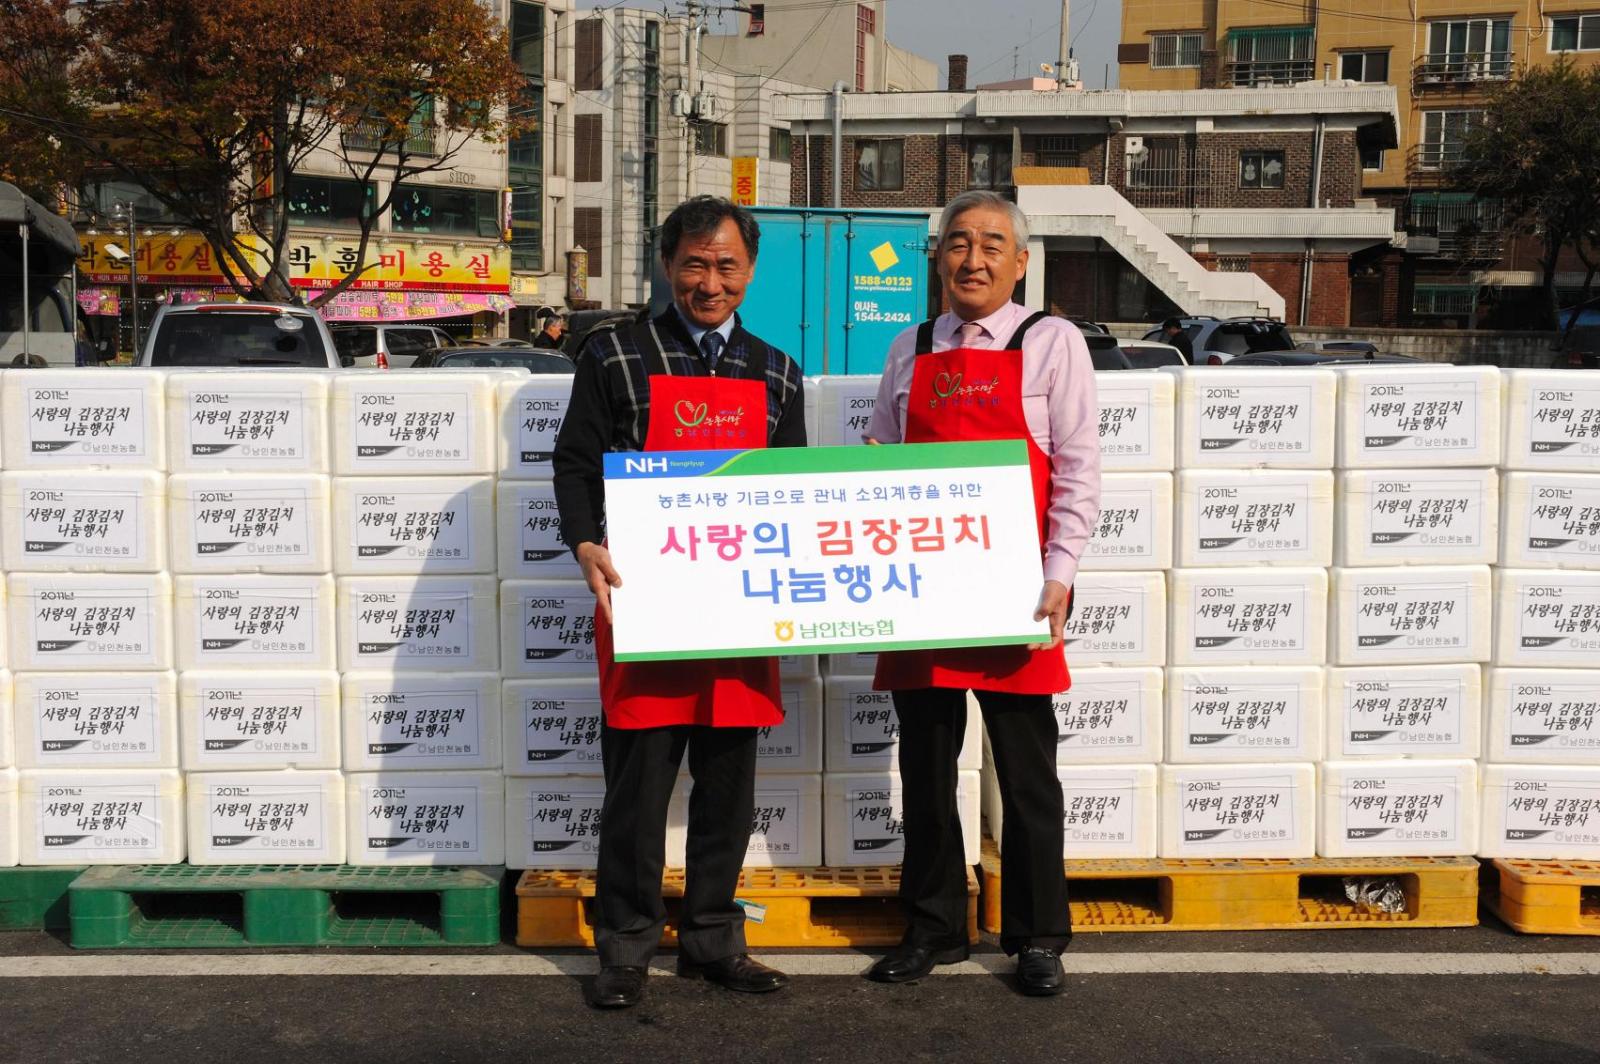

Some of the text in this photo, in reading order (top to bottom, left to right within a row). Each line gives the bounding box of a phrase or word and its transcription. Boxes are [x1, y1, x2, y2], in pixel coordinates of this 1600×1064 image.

[449, 171, 476, 185] SHOP
[378, 250, 491, 279] 미용실
[312, 279, 332, 287] PARK
[361, 280, 379, 288] HAIR
[384, 281, 403, 289] SHOP
[854, 275, 912, 286] 1588-0123
[854, 301, 878, 312] 이사는
[854, 312, 912, 322] 1544-2424
[35, 391, 69, 400] 2011년
[195, 394, 229, 403] 2011년
[1206, 389, 1240, 398] 2011년
[1370, 386, 1404, 396] 2011년
[1539, 392, 1573, 401] 2011년
[361, 395, 395, 405] 2011년
[32, 407, 130, 422] 사랑의 김장김치
[1202, 404, 1298, 420] 사랑의 김장김치
[1366, 400, 1463, 417] 사랑의 김장김치
[1534, 407, 1573, 423] 사랑의
[192, 410, 289, 425] 사랑의 김장김치
[358, 411, 455, 426] 사랑의 김장김치
[522, 418, 561, 432] 사랑의
[1397, 416, 1447, 431] 나눔행사
[64, 422, 115, 436] 나눔행사
[224, 425, 274, 439] 나눔행사
[389, 427, 440, 441] 나눔행사
[1233, 419, 1282, 434] 나눔행사
[93, 444, 137, 453] 남인천농협
[1259, 441, 1302, 450] 남인천농협
[625, 457, 668, 473] NH
[658, 482, 983, 509] 농촌사랑 기금으로 관내 소외계층을 위한
[1378, 483, 1411, 493] 2011년
[199, 492, 233, 502] 2011년
[1201, 502, 1295, 519] 사랑의 김장김치
[1374, 498, 1468, 514] 사랑의 김장김치
[1533, 504, 1572, 520] 사랑의
[26, 507, 124, 524] 사랑의 김장김치
[197, 506, 294, 524] 사랑의 김장김치
[358, 511, 455, 527] 사랑의 김장김치
[1404, 513, 1453, 528] 나눔행사
[58, 523, 108, 538] 나눔행사
[229, 522, 279, 537] 나눔행사
[1231, 518, 1280, 533] 나눔행사
[390, 526, 440, 541] 나눔행사
[660, 513, 991, 562] 사랑의 김장김치
[257, 543, 301, 553] 남인천농협
[742, 562, 923, 605] 나눔행사
[40, 591, 75, 601] 2011년
[362, 593, 396, 603] 2011년
[1201, 588, 1234, 597] 2011년
[37, 606, 136, 622] 사랑의 김장김치
[203, 605, 300, 620] 사랑의 김장김치
[1081, 605, 1131, 620] 김장김치
[1197, 602, 1292, 618] 사랑의 김장김치
[1359, 600, 1455, 617] 사랑의 김장김치
[1524, 603, 1562, 618] 사랑의
[359, 609, 455, 624] 사랑의 김장김치
[527, 615, 565, 629] 사랑의
[1390, 615, 1439, 631] 나눔행사
[69, 621, 120, 636] 나눔행사
[234, 620, 285, 634] 나눔행사
[390, 624, 440, 638] 나눔행사
[800, 619, 895, 640] 남인천농협
[1066, 620, 1115, 634] 나눔행사
[1227, 617, 1276, 632] 나눔행사
[418, 645, 461, 654] 남인천농협
[208, 690, 242, 700] 2011년
[1195, 685, 1228, 695] 2011년
[1078, 699, 1128, 714] 김장김치
[1191, 701, 1286, 715] 사랑의 김장김치
[1352, 697, 1447, 712] 사랑의 김장김치
[1514, 701, 1552, 716] 사랑의
[42, 705, 140, 722] 사랑의 김장김치
[205, 705, 302, 721] 사랑의 김장김치
[369, 708, 465, 725] 사랑의 김장김치
[853, 709, 890, 725] 사랑의
[1382, 712, 1432, 726] 나눔행사
[74, 720, 125, 735] 나눔행사
[237, 720, 287, 735] 나눔행사
[528, 716, 567, 731] 사랑의
[1064, 715, 1112, 729] 나눔행사
[1221, 715, 1271, 729] 나눔행사
[400, 723, 450, 738] 나눔행사
[1409, 732, 1452, 742] 남인천농협
[265, 741, 308, 751] 남인천농협
[48, 787, 82, 796] 2011년
[1352, 779, 1385, 789] 2011년
[45, 801, 142, 817] 사랑의 김장김치
[213, 802, 309, 817] 사랑의 김장김치
[1071, 796, 1120, 810] 김장김치
[1185, 793, 1280, 812] 사랑의 김장김치
[1349, 794, 1443, 810] 사랑의 김장김치
[1509, 796, 1547, 812] 사랑의
[369, 804, 464, 819] 사랑의 김장김치
[534, 808, 572, 823] 사랑의
[855, 806, 892, 821] 사랑의
[1216, 808, 1265, 825] 나눔행사
[1379, 809, 1428, 823] 나눔행사
[76, 816, 127, 831] 나눔행사
[244, 817, 294, 831] 나눔행사
[400, 819, 449, 833] 나눔행사
